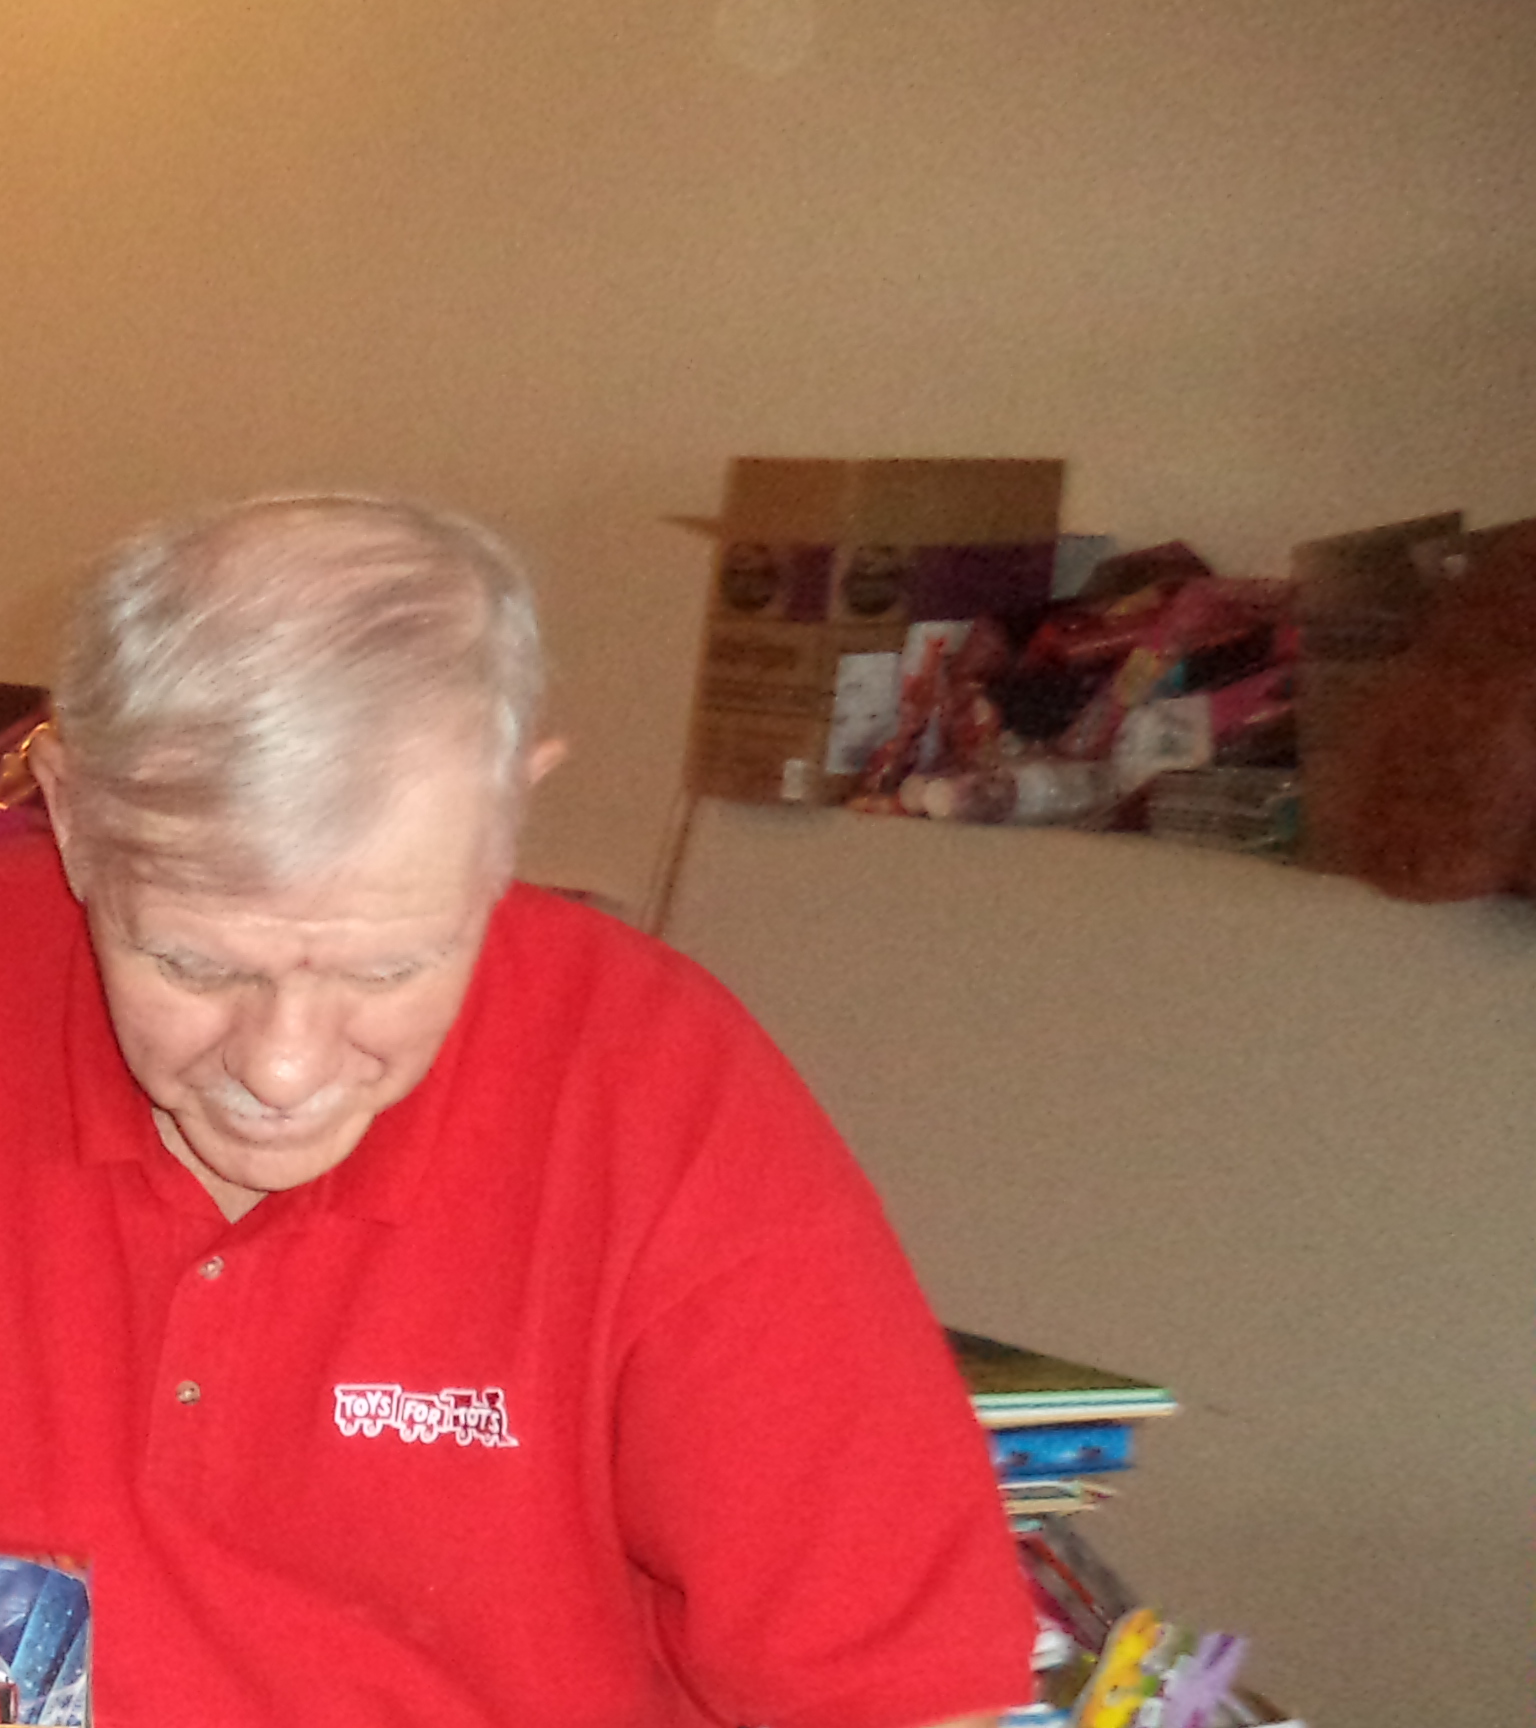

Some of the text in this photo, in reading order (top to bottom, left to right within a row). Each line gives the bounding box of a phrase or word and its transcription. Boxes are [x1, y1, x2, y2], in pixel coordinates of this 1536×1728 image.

[343, 1391, 501, 1434] TOYS FOR TOTS
